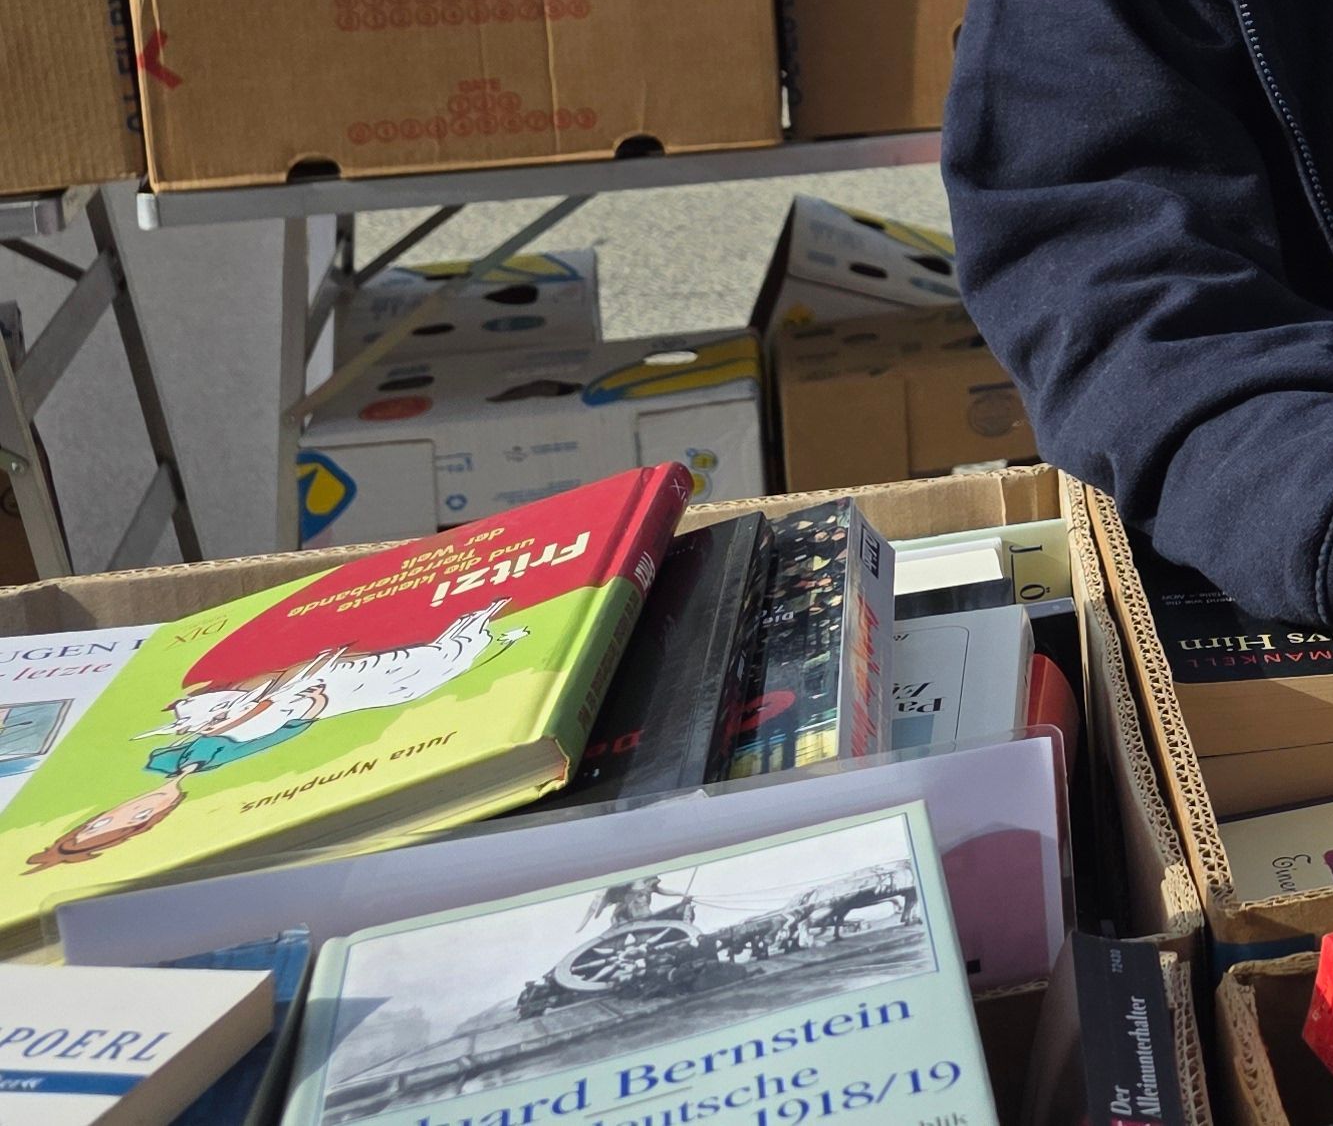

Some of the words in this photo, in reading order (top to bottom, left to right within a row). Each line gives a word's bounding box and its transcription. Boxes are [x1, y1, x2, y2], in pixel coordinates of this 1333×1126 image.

[463, 527, 506, 547] der
[487, 537, 536, 563] und
[400, 544, 460, 572] Welt
[429, 530, 592, 608] Fritzi
[443, 556, 484, 577] die
[286, 545, 477, 619] Tierretterbande
[336, 573, 436, 613] kleinste
[1178, 633, 1276, 653] Hirn
[1187, 649, 1333, 669] MANKELL
[12, 663, 113, 682] letzte
[389, 729, 458, 762] Jutta
[239, 759, 378, 816] Nymphius
[612, 996, 912, 1104] Bernstein
[1125, 995, 1162, 1119] Alleinunterhalter
[752, 1059, 963, 1126] 1918/19
[1110, 1084, 1133, 1116] Der
